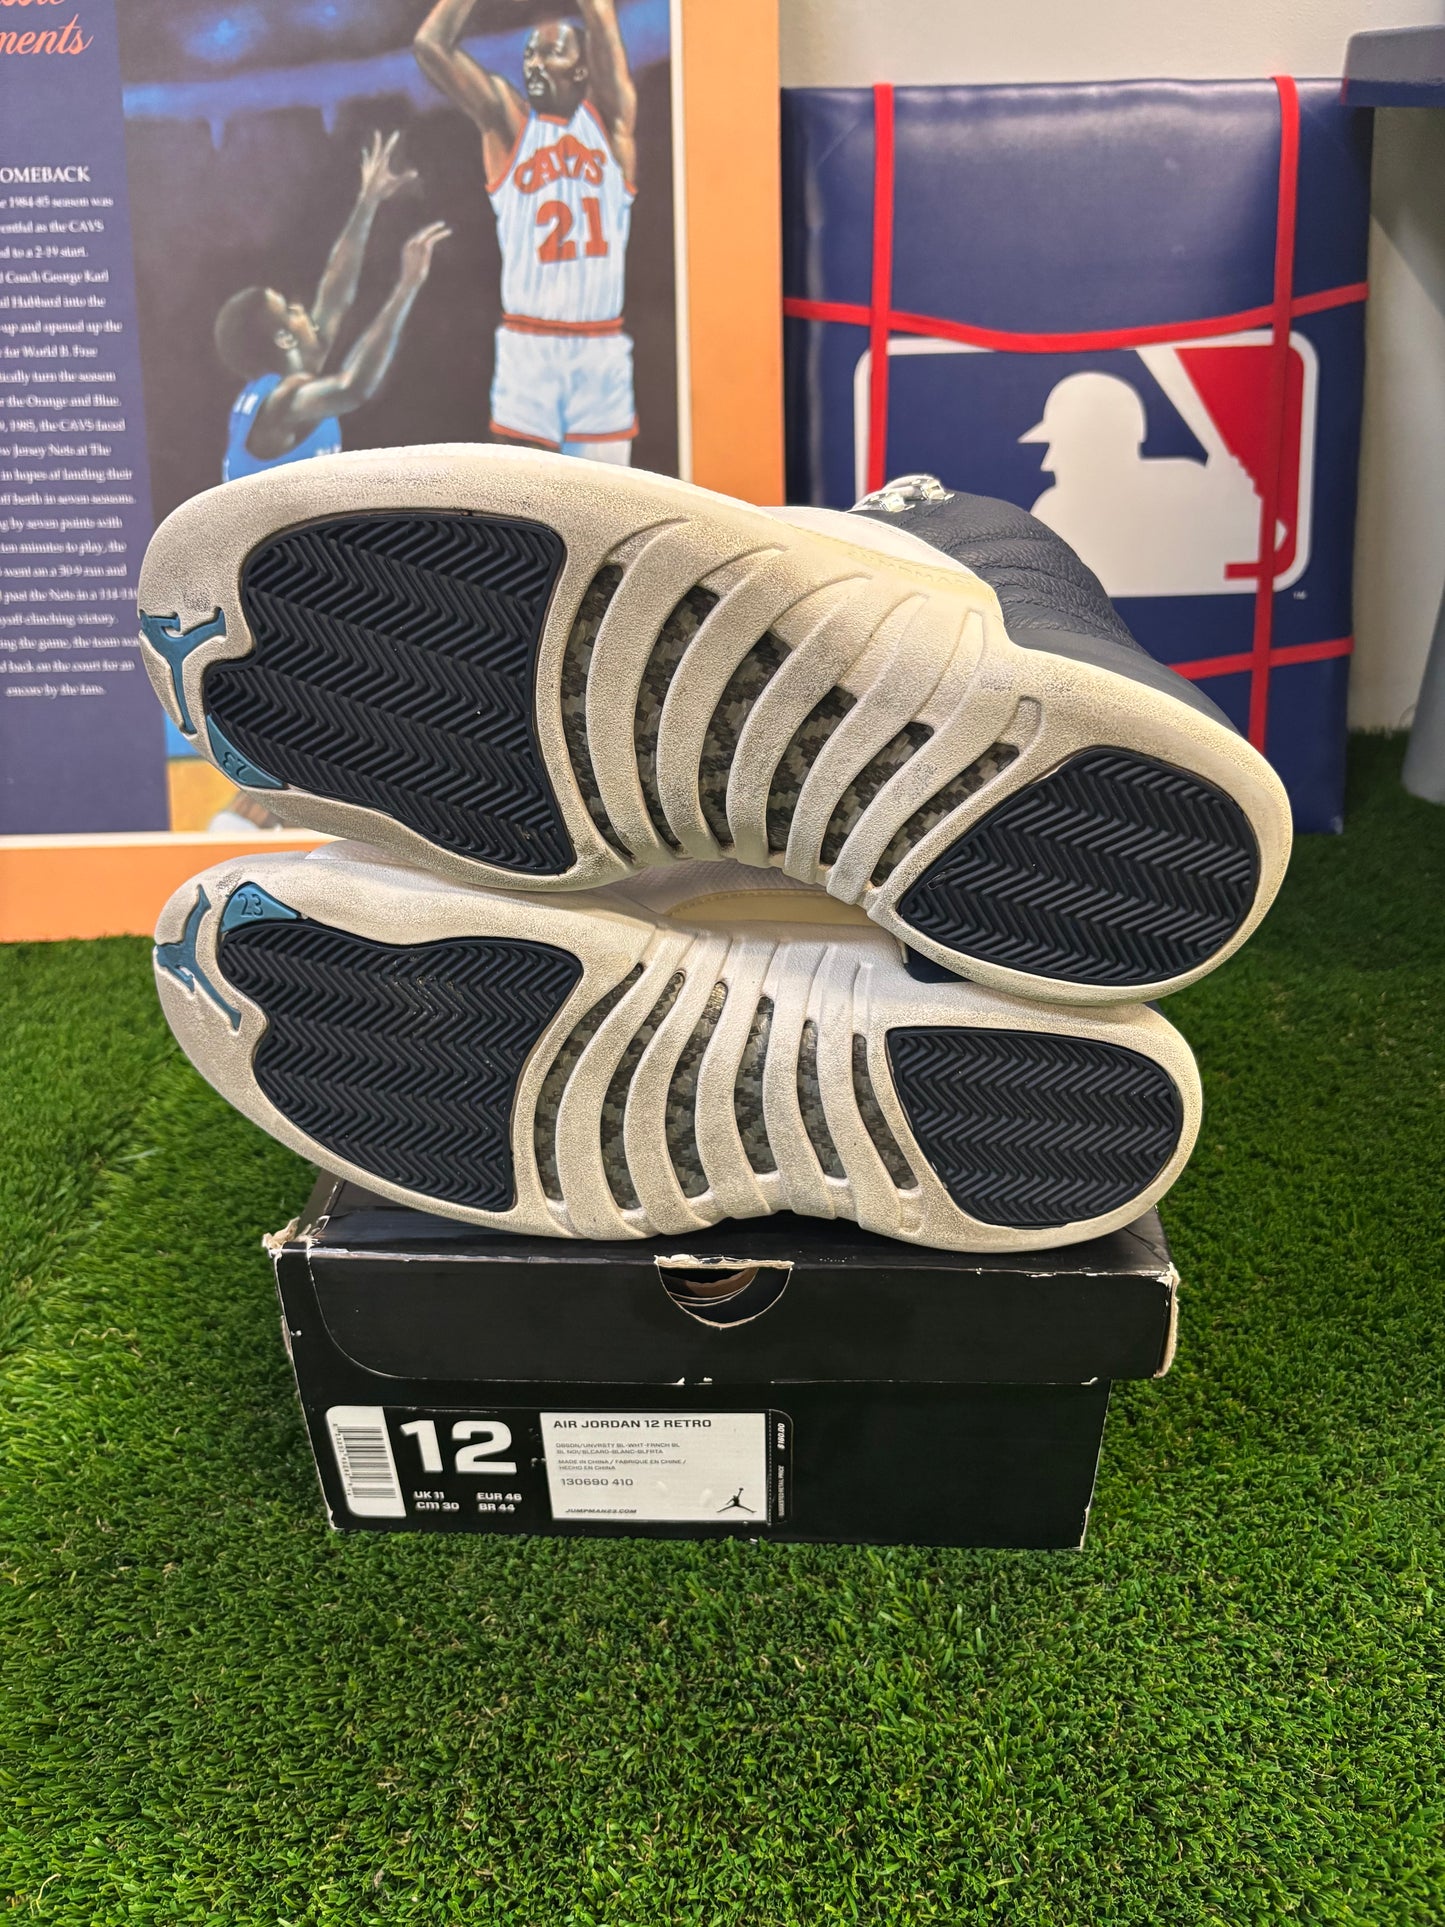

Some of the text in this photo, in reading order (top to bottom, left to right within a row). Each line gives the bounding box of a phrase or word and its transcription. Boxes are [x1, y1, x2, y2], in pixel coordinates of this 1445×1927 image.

[514, 134, 606, 194] CAVS
[0, 166, 91, 183] OMEBACK
[90, 198, 113, 207] was
[35, 224, 48, 233] as
[49, 220, 67, 232] the
[68, 219, 104, 232] CAVS
[536, 197, 608, 263] 21
[12, 247, 24, 258] to
[26, 249, 33, 258] a
[5, 271, 41, 283] Coach
[42, 270, 82, 286] George
[84, 269, 109, 282] Karl
[63, 296, 86, 307] into
[88, 295, 106, 307] the
[20, 321, 41, 333] and
[43, 320, 84, 336] opened
[86, 322, 102, 336] up
[103, 320, 122, 332] the
[22, 345, 58, 357] World
[72, 345, 98, 357] Free
[31, 372, 57, 382] turn
[58, 370, 77, 382] the
[78, 372, 116, 382] season
[7, 395, 25, 407] the
[25, 395, 69, 410] Orange
[70, 394, 91, 407] and
[40, 420, 60, 431] the
[60, 419, 94, 431] CAVS
[12, 443, 46, 459] Jersey
[47, 443, 75, 456] Nets
[76, 444, 88, 456] at
[89, 443, 112, 456] The
[14, 468, 48, 484] hopes
[49, 468, 61, 480] of
[61, 468, 106, 483] landing
[12, 493, 43, 505] berth
[44, 493, 56, 504] in
[25, 518, 59, 529] seven
[60, 517, 95, 532] points
[96, 516, 123, 528] with
[19, 542, 65, 553] minutes
[65, 542, 78, 553] to
[107, 540, 127, 552] the
[4, 566, 31, 577] went
[33, 568, 49, 577] on
[105, 564, 127, 576] and
[4, 589, 27, 605] past
[29, 589, 48, 601] the
[49, 588, 76, 601] Nets
[19, 636, 38, 649] the
[38, 638, 72, 652] game,
[72, 636, 91, 648] the
[91, 637, 121, 648] team
[36, 662, 52, 672] on
[52, 660, 72, 672] the
[72, 661, 101, 672] court
[60, 683, 80, 695] the
[238, 893, 263, 917] 23
[553, 1419, 712, 1428] AIR JORDAN 12 RETRO
[400, 1420, 517, 1473] 12
[561, 1478, 633, 1486] 130690 410
[414, 1490, 522, 1502] UK 11 EUR 46
[442, 1501, 460, 1512] 30
[478, 1502, 496, 1512] BR
[498, 1502, 515, 1512] 44
